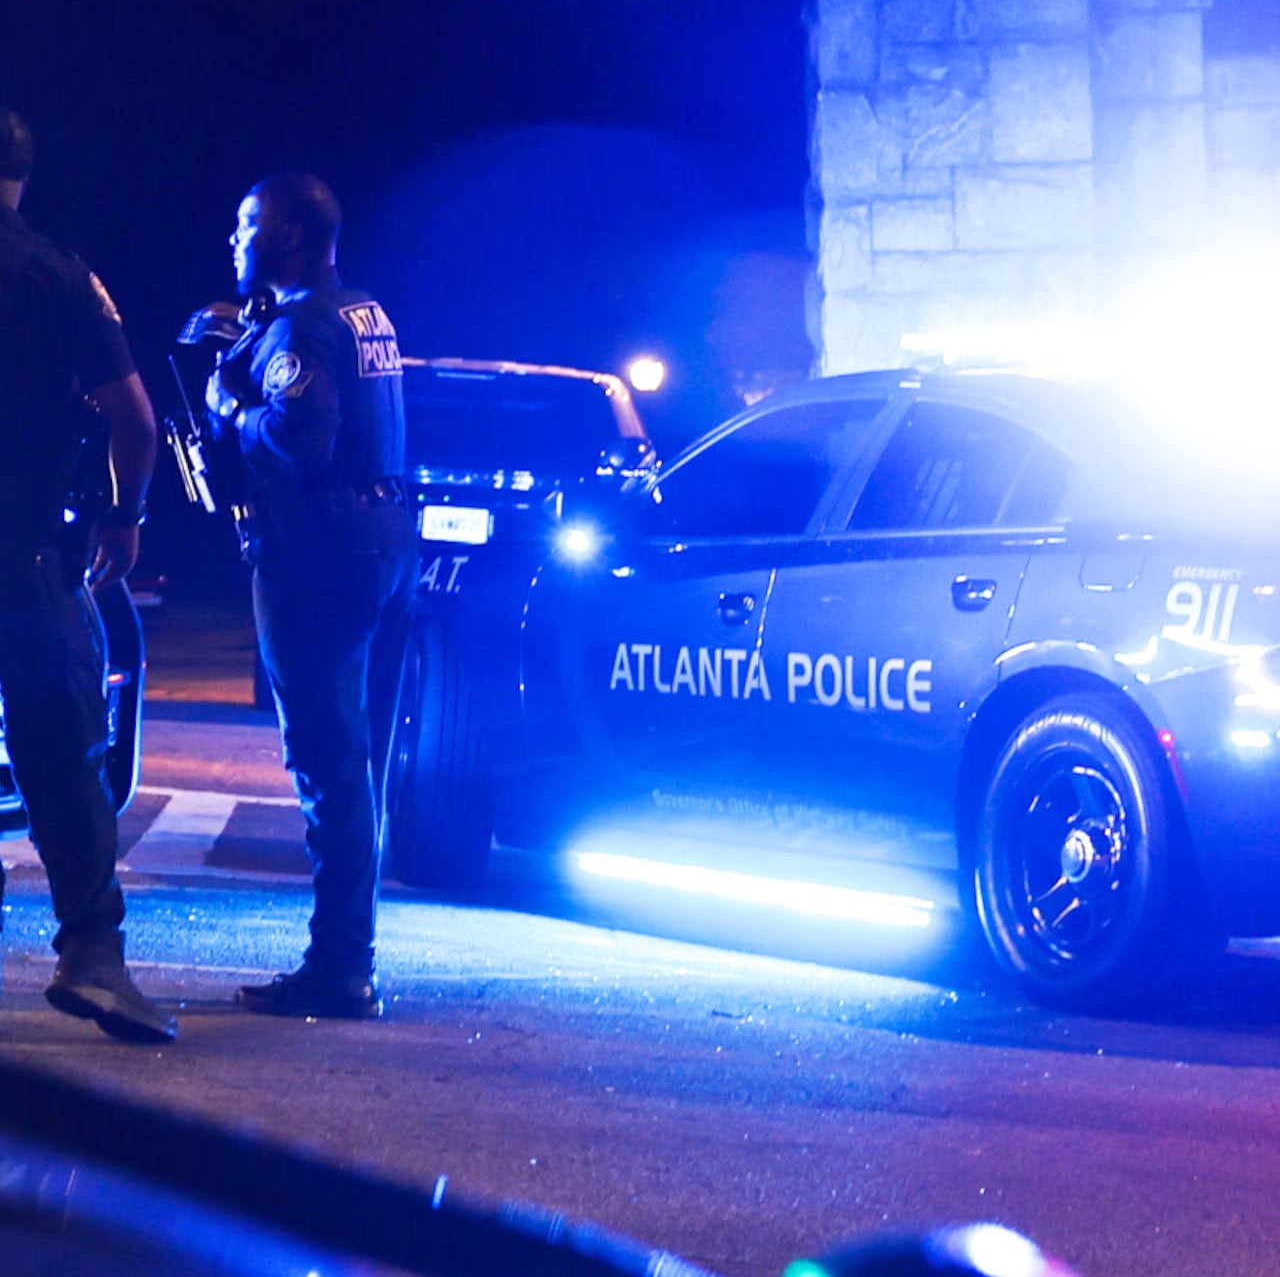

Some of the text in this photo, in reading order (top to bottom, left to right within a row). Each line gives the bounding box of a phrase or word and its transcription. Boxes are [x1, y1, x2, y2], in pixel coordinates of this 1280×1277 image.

[361, 339, 402, 371] POLIC
[419, 555, 470, 593] A.T.
[1161, 581, 1239, 642] 911
[610, 642, 933, 712] ATLANTA POLICE
